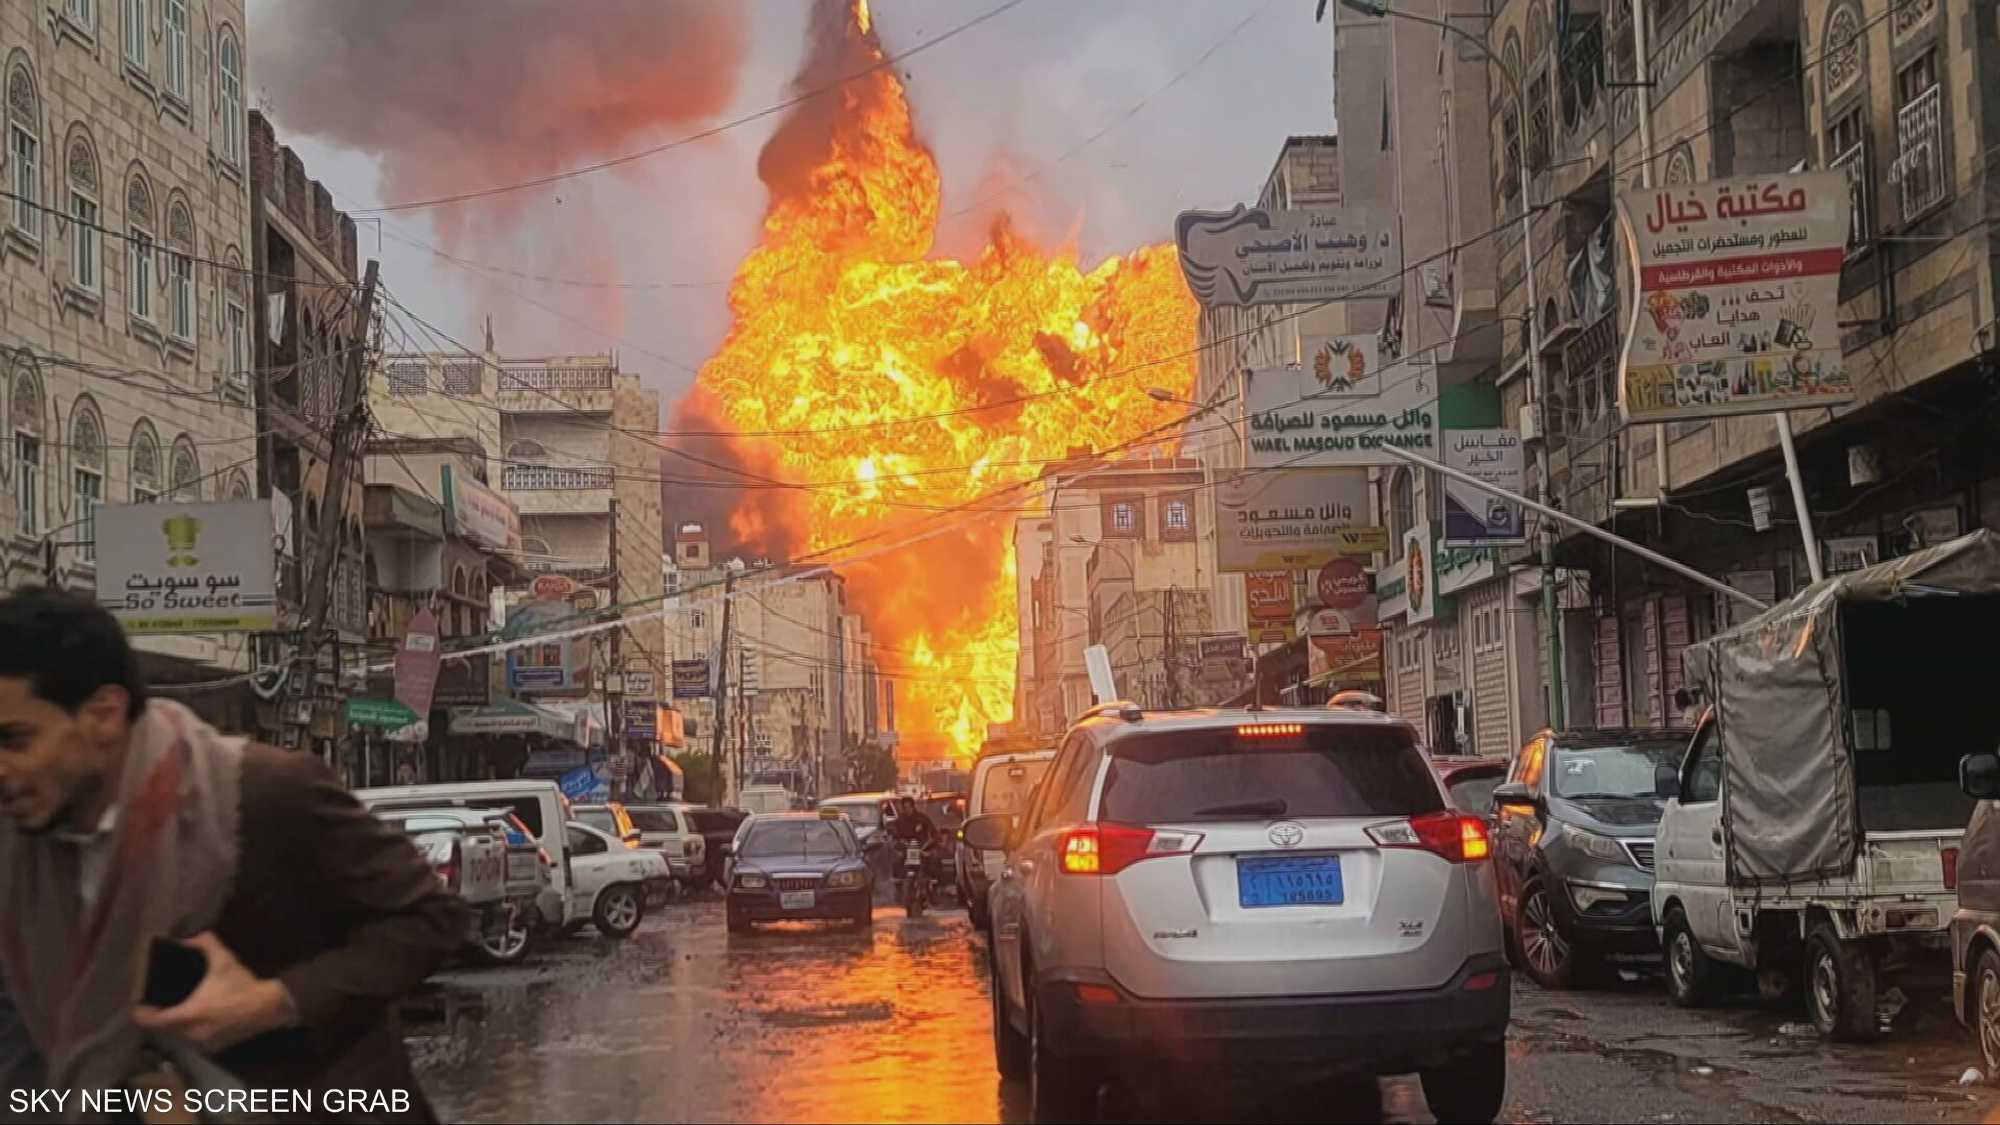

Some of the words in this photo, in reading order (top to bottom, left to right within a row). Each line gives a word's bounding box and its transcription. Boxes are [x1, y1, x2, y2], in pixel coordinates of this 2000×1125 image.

[1646, 189, 1708, 234] خيال
[1716, 182, 1807, 227] مكتبة
[1235, 230, 1309, 258] الأصبحي
[1652, 238, 1695, 258] التجميل
[1697, 231, 1765, 253] ومستحضرات
[1766, 227, 1808, 248] للعطور
[1745, 284, 1785, 303] تحف
[1716, 309, 1761, 327] هدايا
[1251, 411, 1313, 432] للصرافة
[1321, 413, 1387, 431] مسعود
[1393, 408, 1432, 430] وائل
[1251, 437, 1290, 453] WAEL
[1294, 437, 1354, 451] MASOUD
[1359, 434, 1433, 448] EXCHANGE
[1237, 506, 1315, 523] مسعود
[1320, 503, 1352, 521] وائل
[125, 573, 199, 598] سويت
[206, 574, 241, 595] سو
[126, 593, 156, 610] So
[164, 592, 241, 609] Sweet
